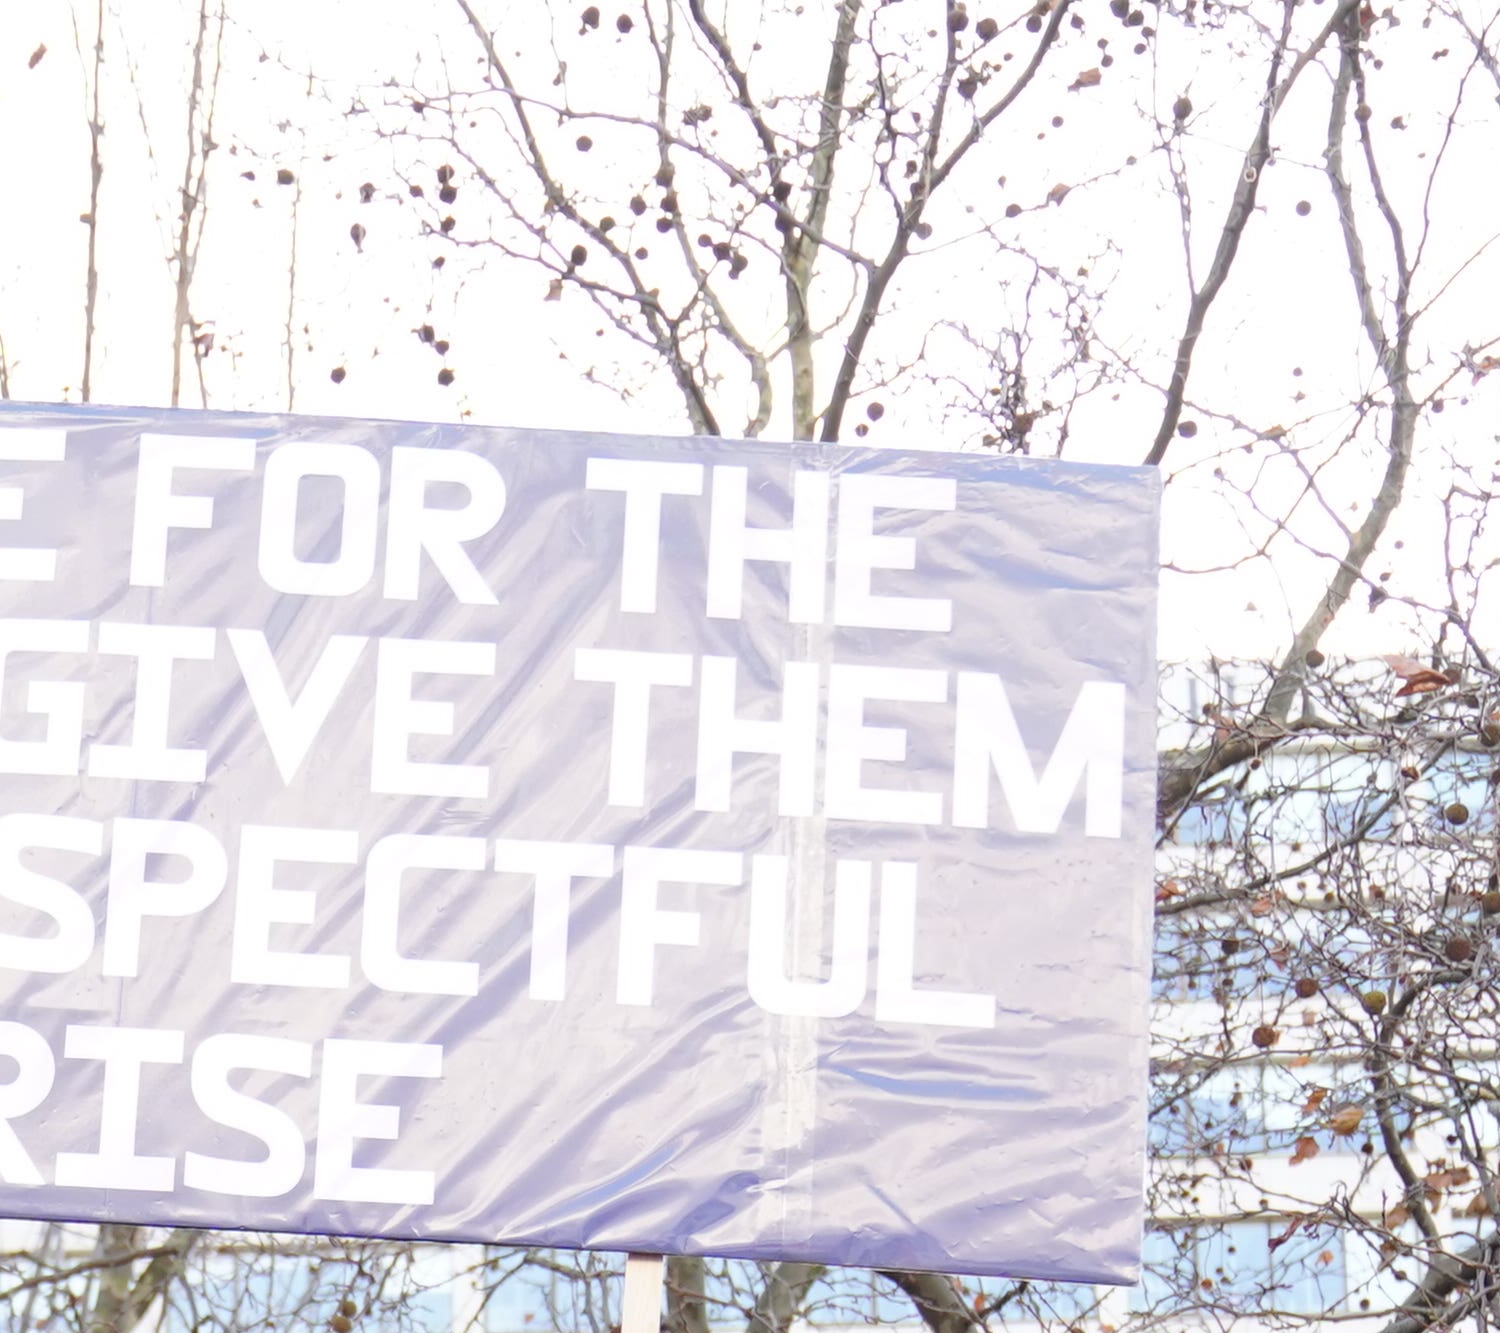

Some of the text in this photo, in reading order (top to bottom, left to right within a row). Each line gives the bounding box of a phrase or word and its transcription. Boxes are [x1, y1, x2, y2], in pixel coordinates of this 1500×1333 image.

[128, 432, 505, 606] FOR
[584, 458, 959, 634] THE
[576, 648, 1127, 840] THEM
